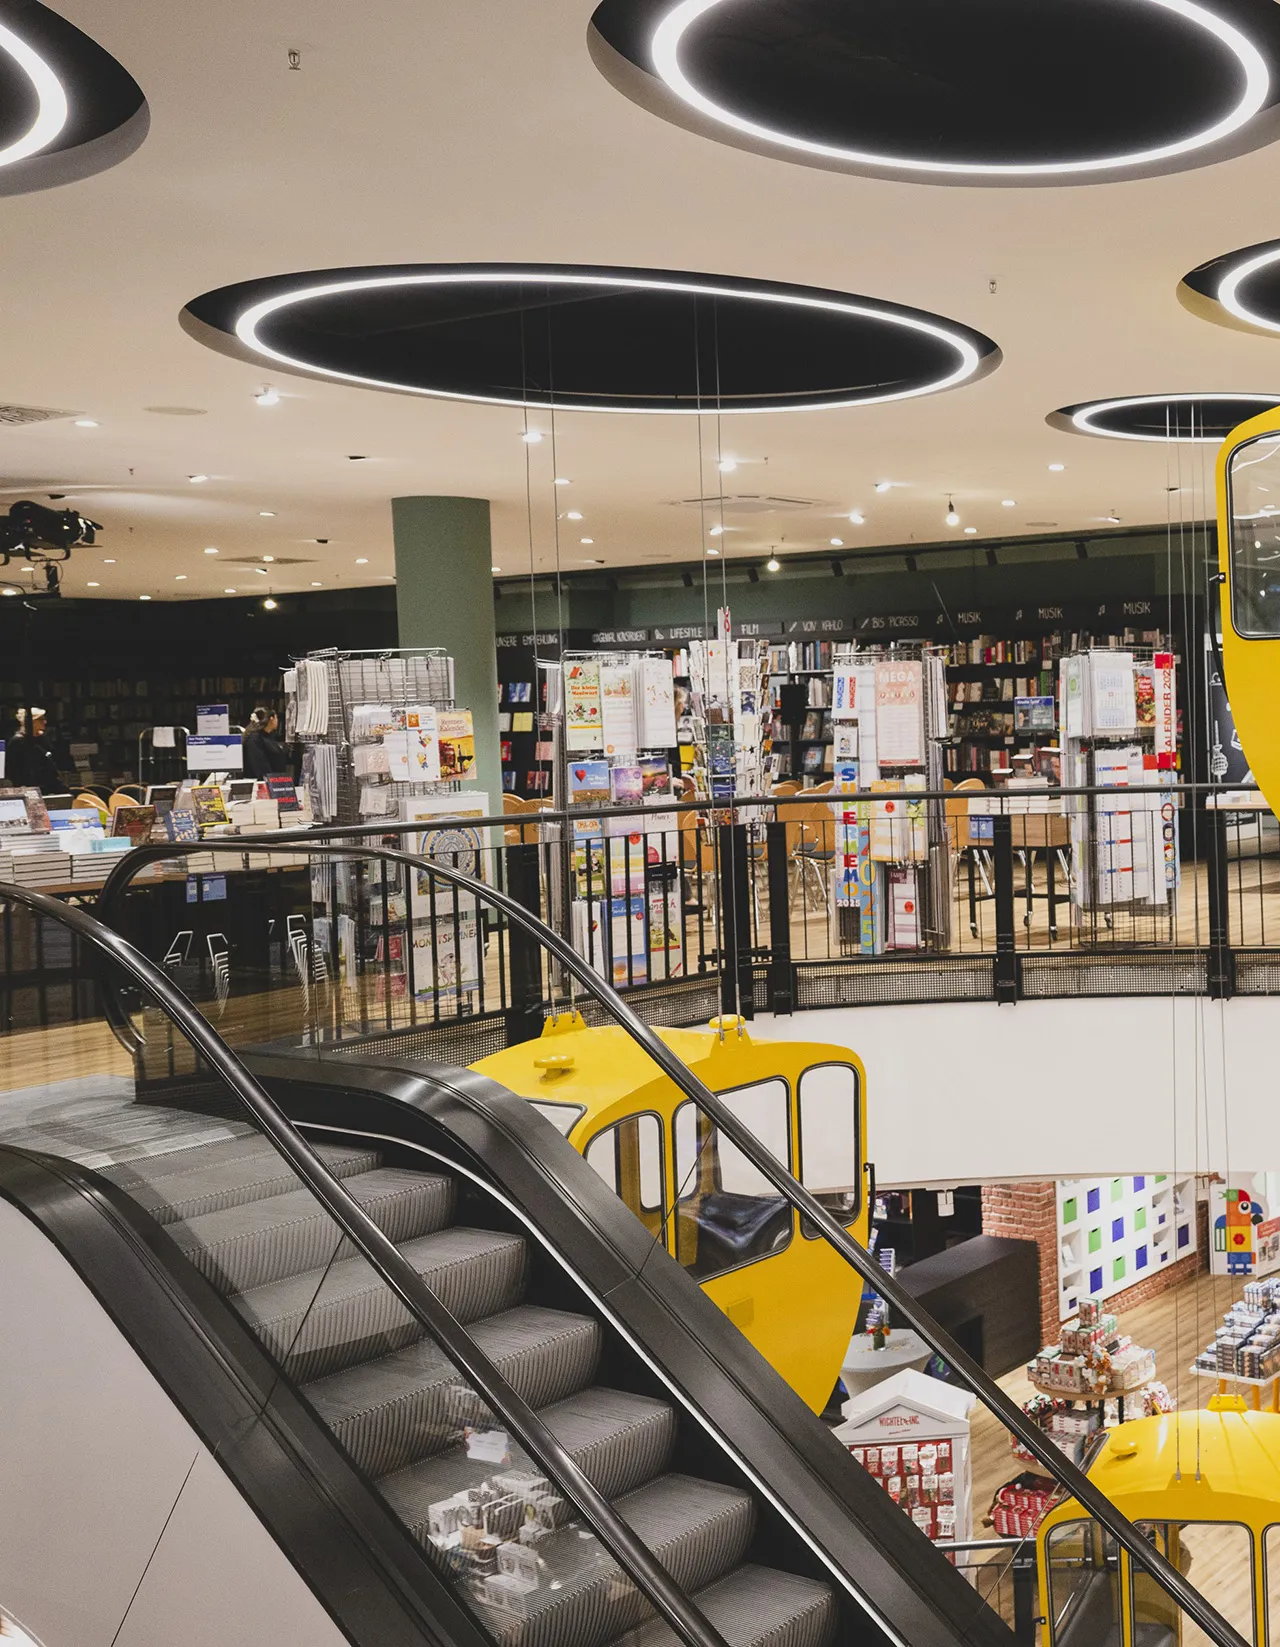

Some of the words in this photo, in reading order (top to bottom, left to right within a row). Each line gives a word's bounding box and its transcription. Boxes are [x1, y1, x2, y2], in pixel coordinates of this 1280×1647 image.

[1038, 607, 1064, 620] MUSIK
[1123, 602, 1151, 615] MUSIK
[958, 611, 982, 624] MUSIK
[741, 624, 759, 635] FILM
[803, 621, 817, 632] VON
[822, 619, 843, 631] KAHLO
[670, 627, 703, 640] LIFESTYLE
[878, 671, 915, 683] MEGA
[837, 898, 861, 907] 2025
